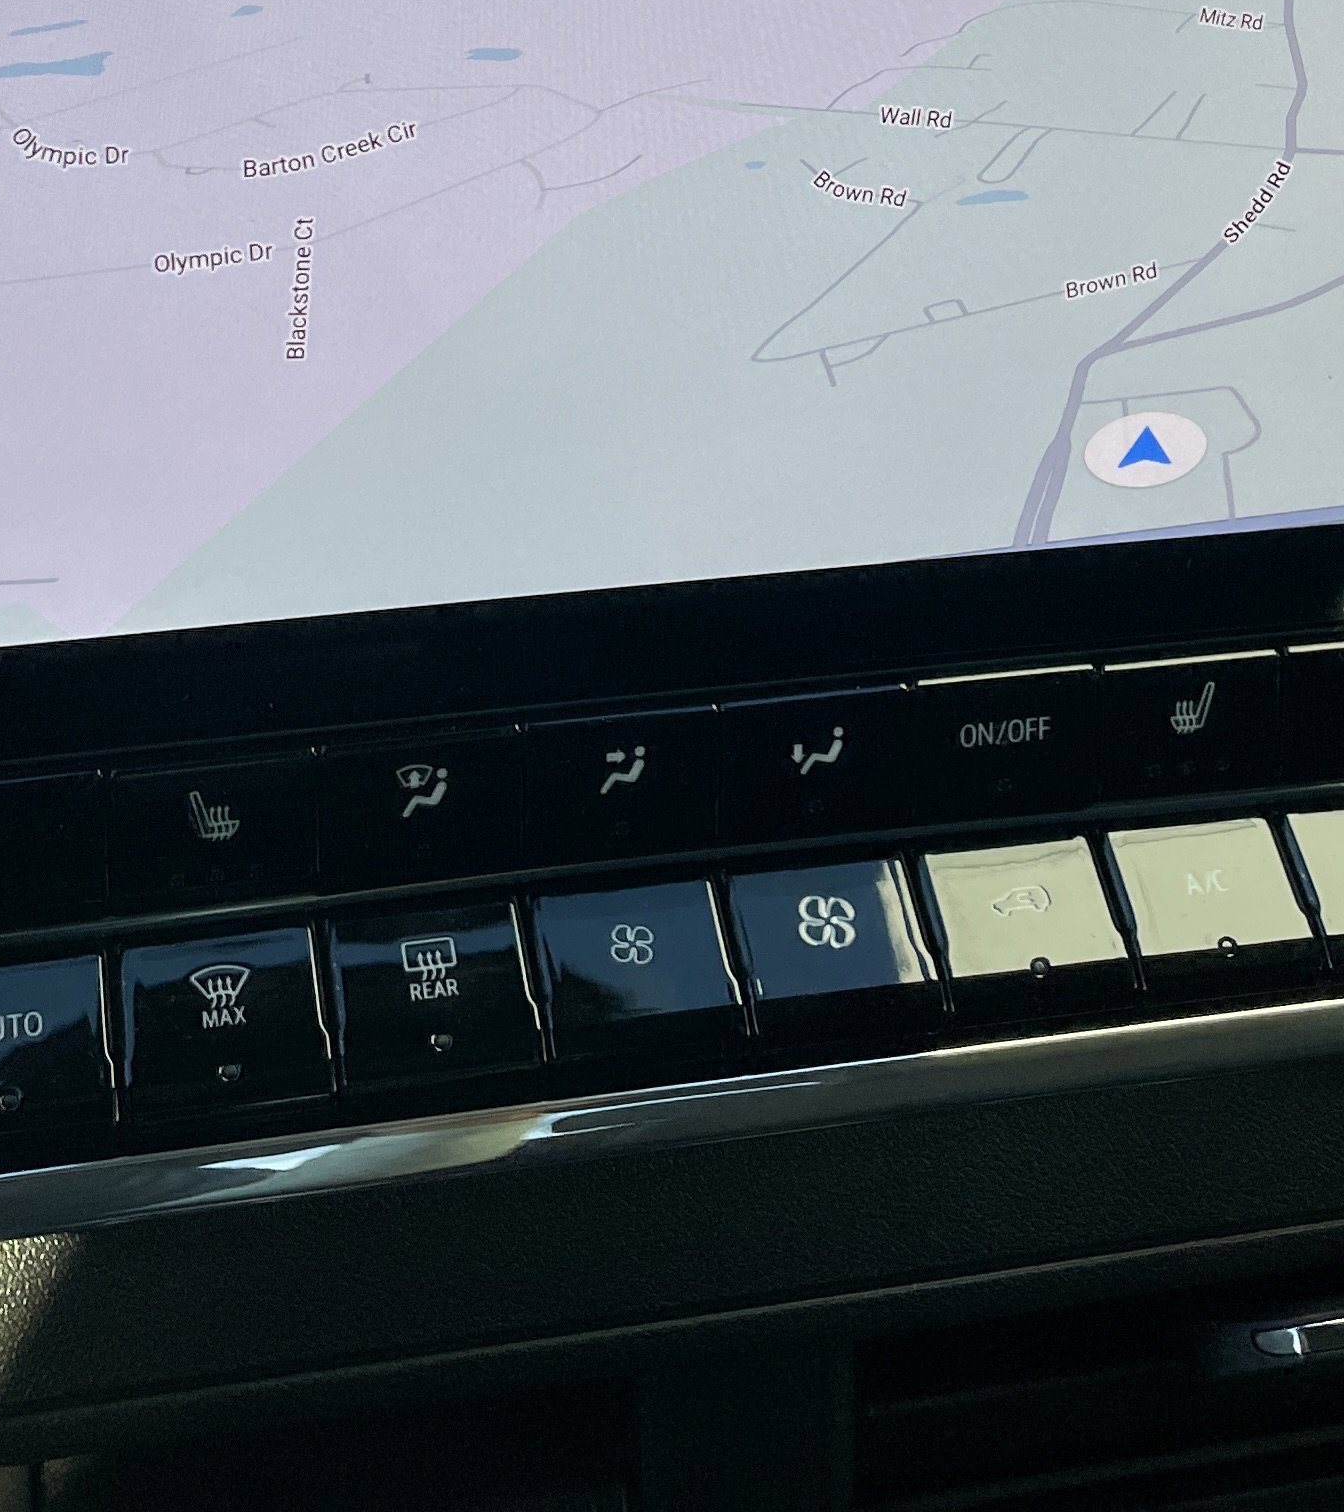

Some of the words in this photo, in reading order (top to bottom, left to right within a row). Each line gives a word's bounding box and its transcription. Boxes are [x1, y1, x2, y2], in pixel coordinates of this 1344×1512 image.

[1200, 8, 1236, 29] Mitz
[1240, 12, 1264, 30] Rd
[880, 107, 922, 128] Wall
[926, 110, 952, 129] Rd
[12, 128, 98, 169] Olympic
[105, 145, 129, 166] Dr
[243, 151, 315, 178] Barton
[320, 133, 383, 165] Creek
[387, 121, 418, 142] Cir
[813, 169, 874, 206] Brown
[879, 187, 907, 208] Rd
[1223, 190, 1274, 245] Shedd
[1267, 160, 1291, 191] Rd
[294, 217, 314, 241] Ct
[154, 246, 243, 276] Olympic
[249, 243, 273, 262] Dr
[1065, 273, 1127, 300] Brown
[1131, 263, 1158, 282] Rd
[286, 245, 312, 360] Blackstone
[960, 716, 1052, 749] ON/OFF
[1186, 870, 1230, 896] A/C
[409, 978, 460, 1003] REAR
[201, 1005, 248, 1030] MAX
